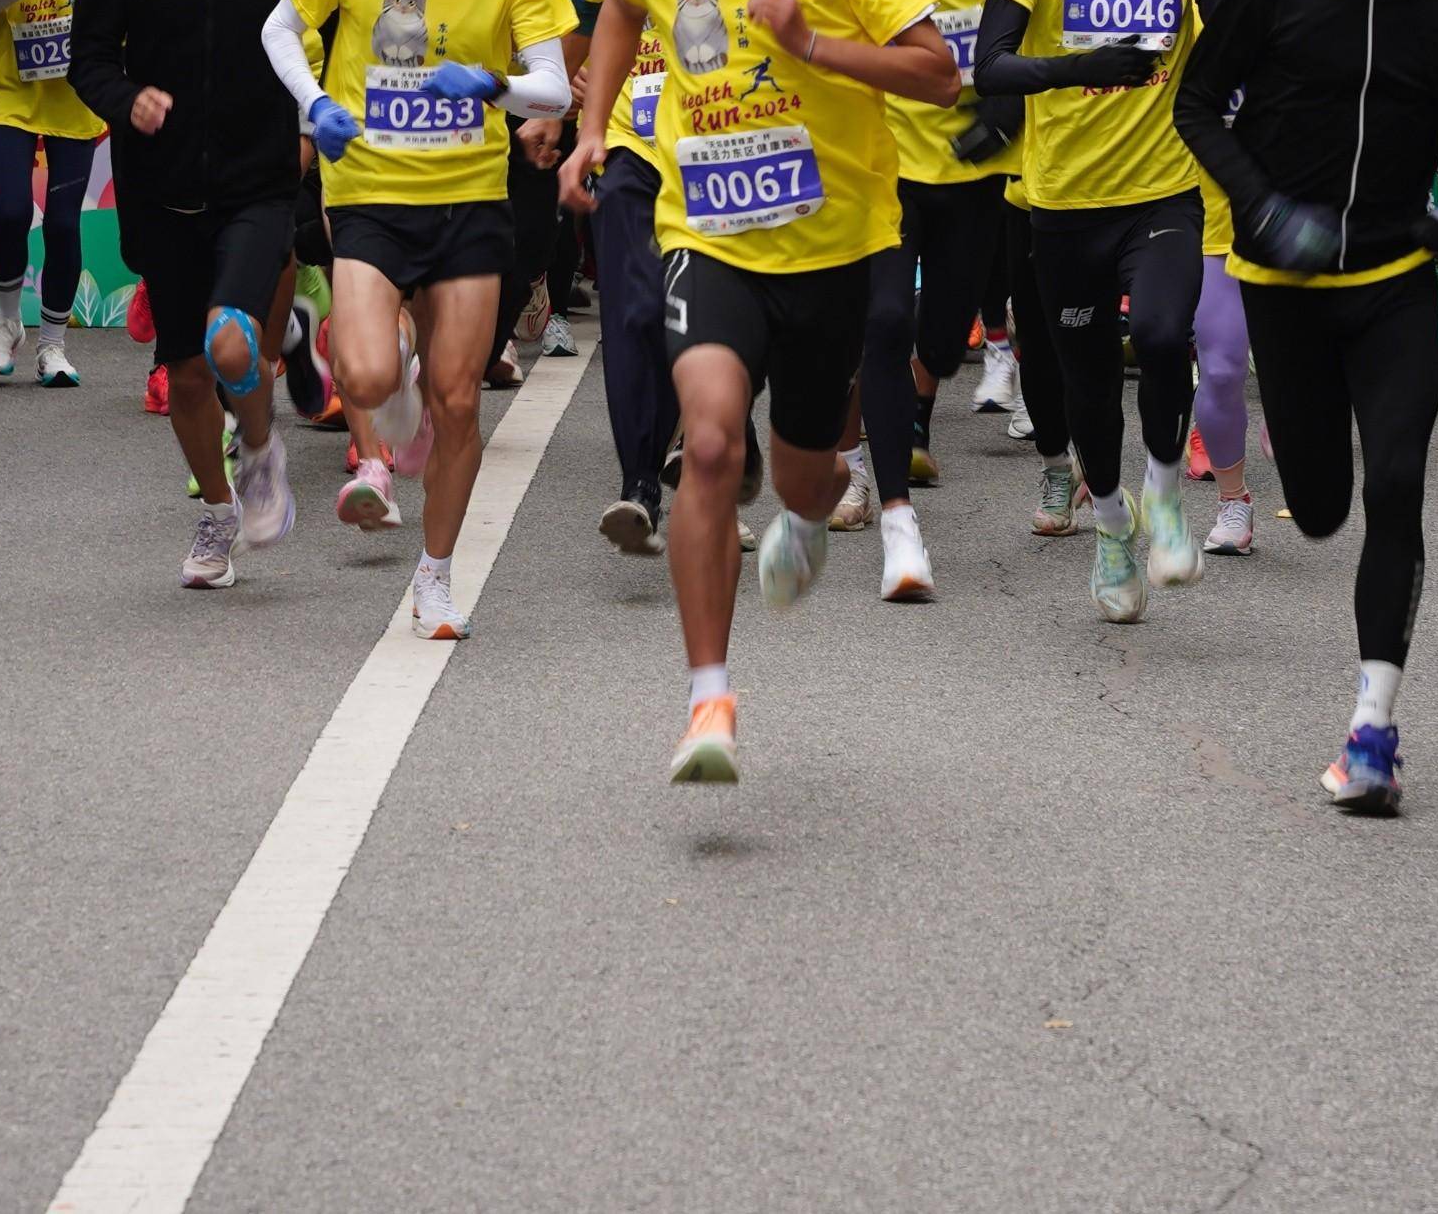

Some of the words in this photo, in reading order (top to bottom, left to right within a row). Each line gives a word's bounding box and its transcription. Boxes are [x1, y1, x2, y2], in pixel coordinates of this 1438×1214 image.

[30, 38, 72, 65] 026
[629, 58, 665, 77] un
[680, 80, 734, 111] Health
[389, 96, 475, 128] 0253
[706, 158, 803, 210] 0067
